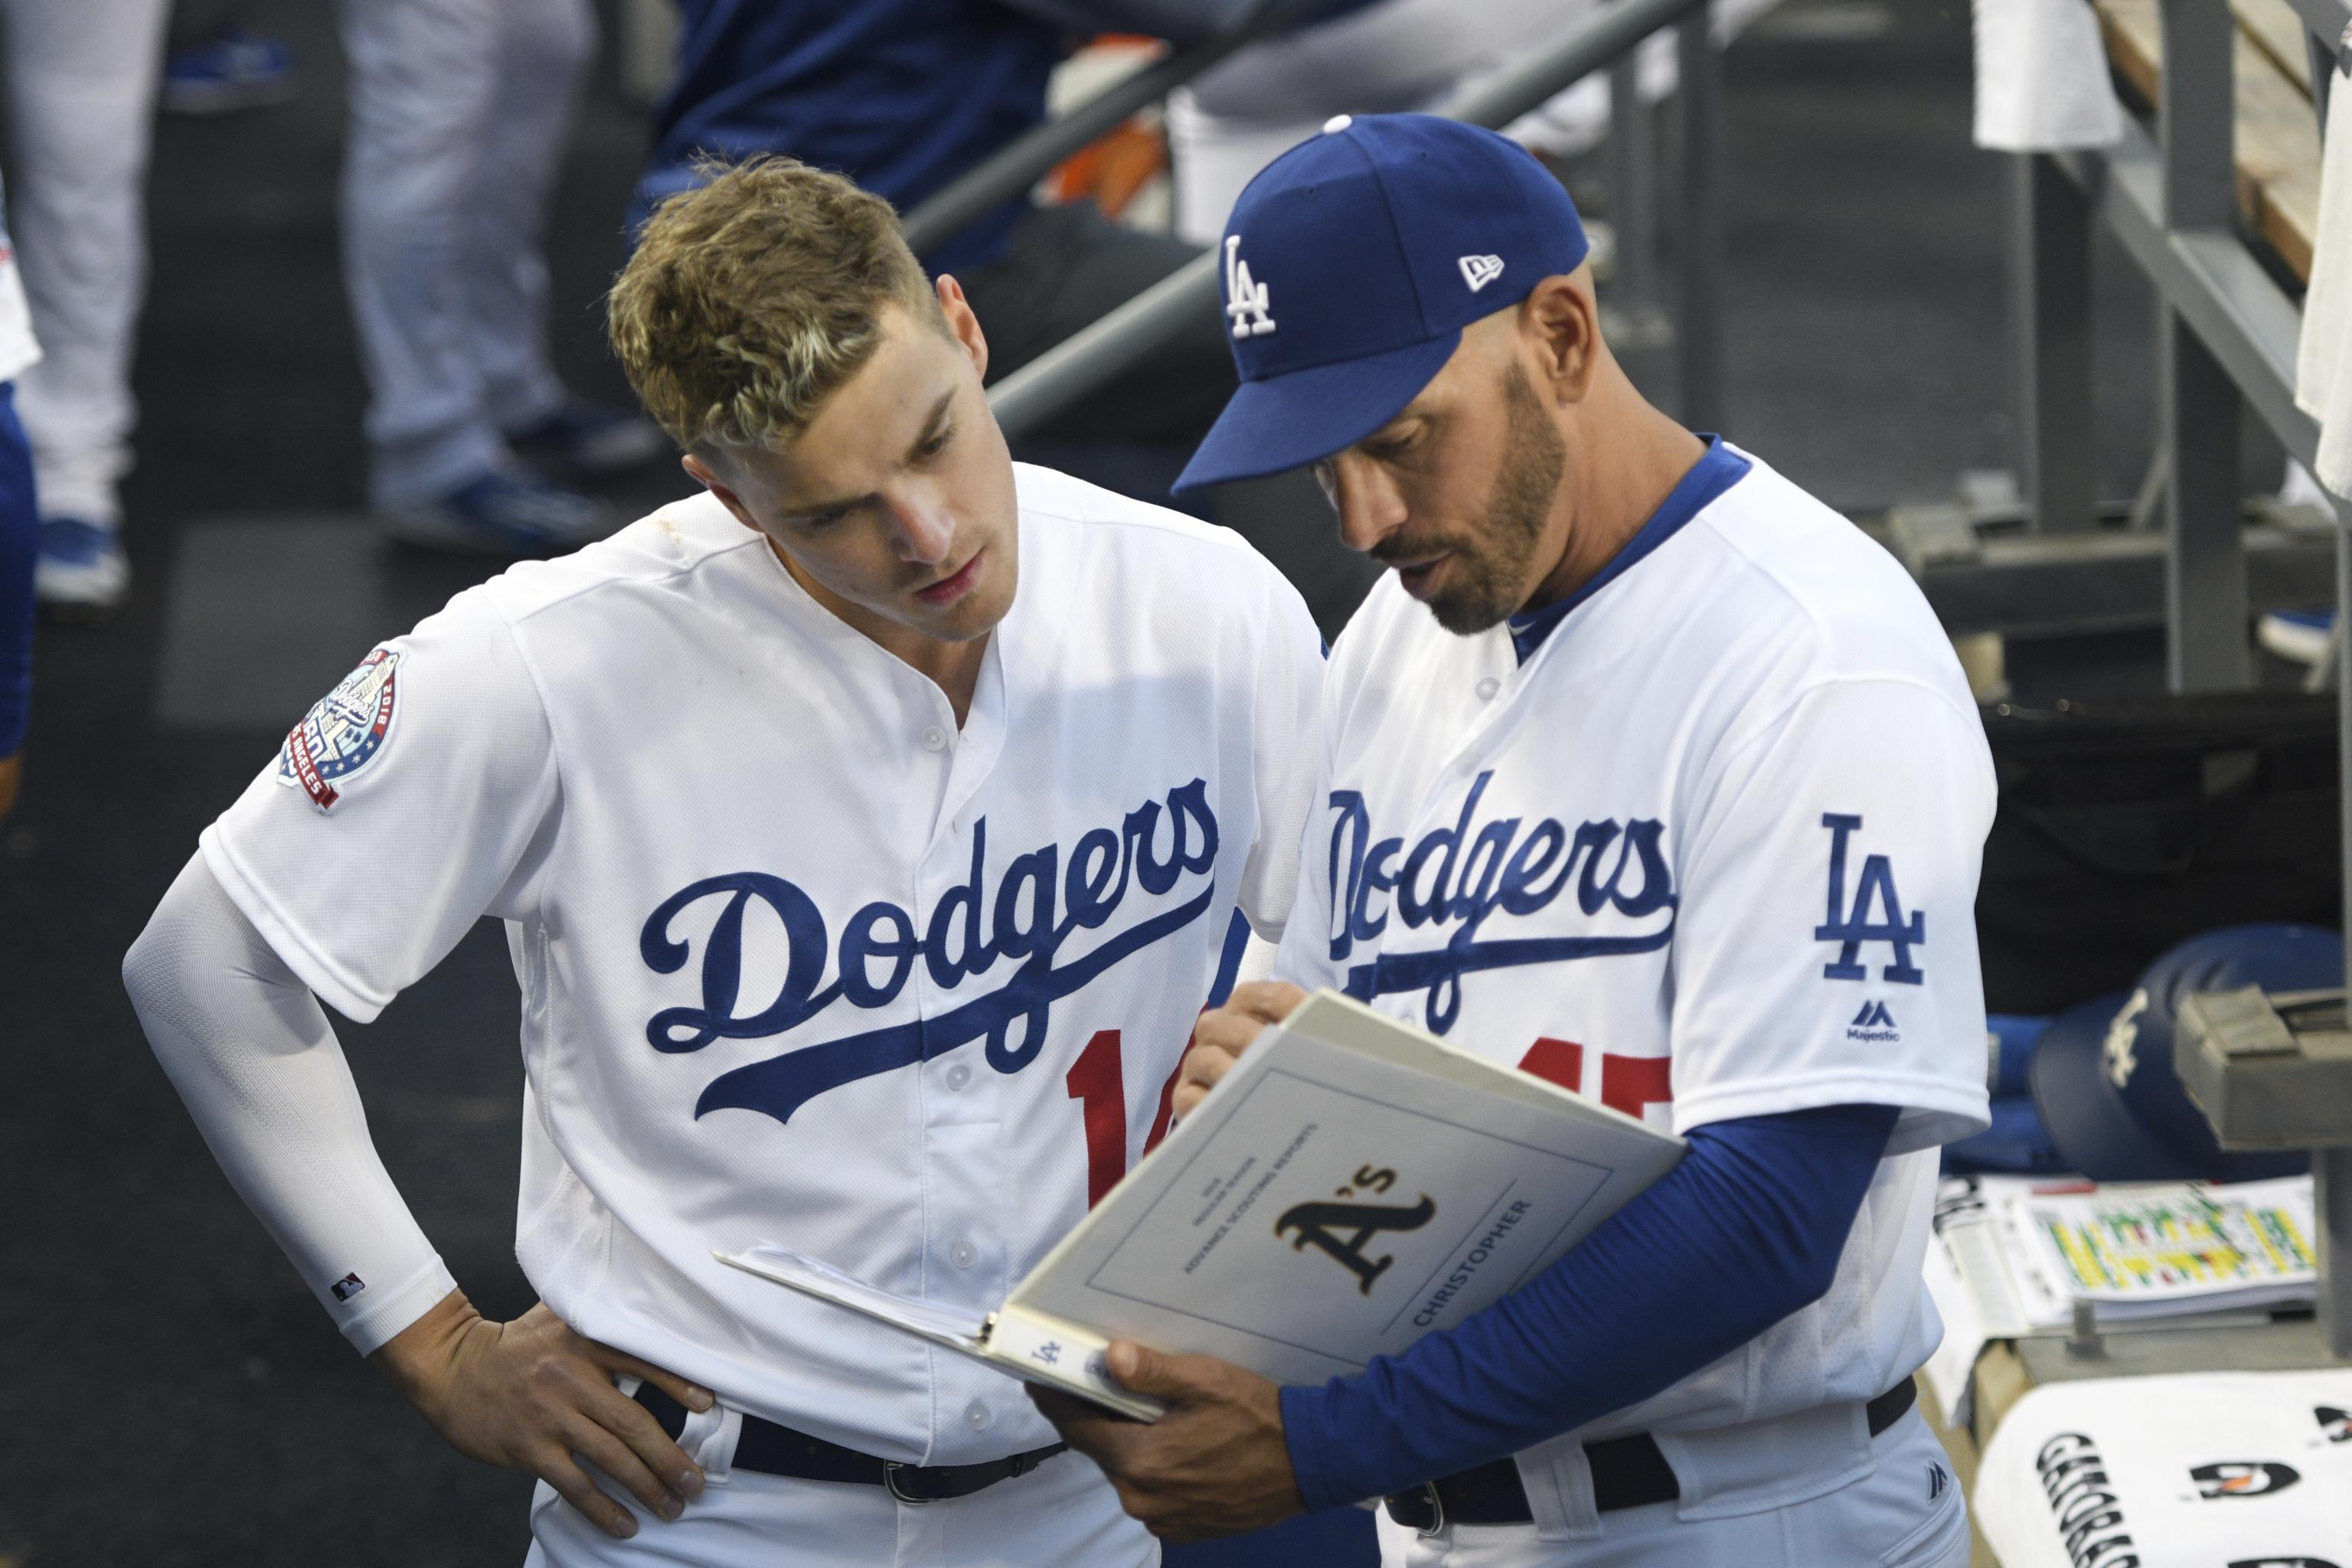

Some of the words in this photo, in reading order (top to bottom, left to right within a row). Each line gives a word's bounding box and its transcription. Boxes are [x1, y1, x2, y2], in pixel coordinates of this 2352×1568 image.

[1226, 235, 1276, 338] LA
[377, 683, 393, 725] 2018
[292, 738, 322, 795] ANGELES
[640, 777, 1220, 1073] Dodgers
[1329, 769, 1677, 1037] Dodgers
[1815, 812, 1926, 986] LA
[1847, 1028, 1901, 1044] Majestic
[1273, 1123, 1318, 1170] REPORTS
[1227, 1171, 1277, 1225] SCOUTING
[1274, 1164, 1437, 1297] A's
[1184, 1225, 1230, 1274] ADVANCE
[1413, 1200, 1533, 1327] CHRISTOPHER
